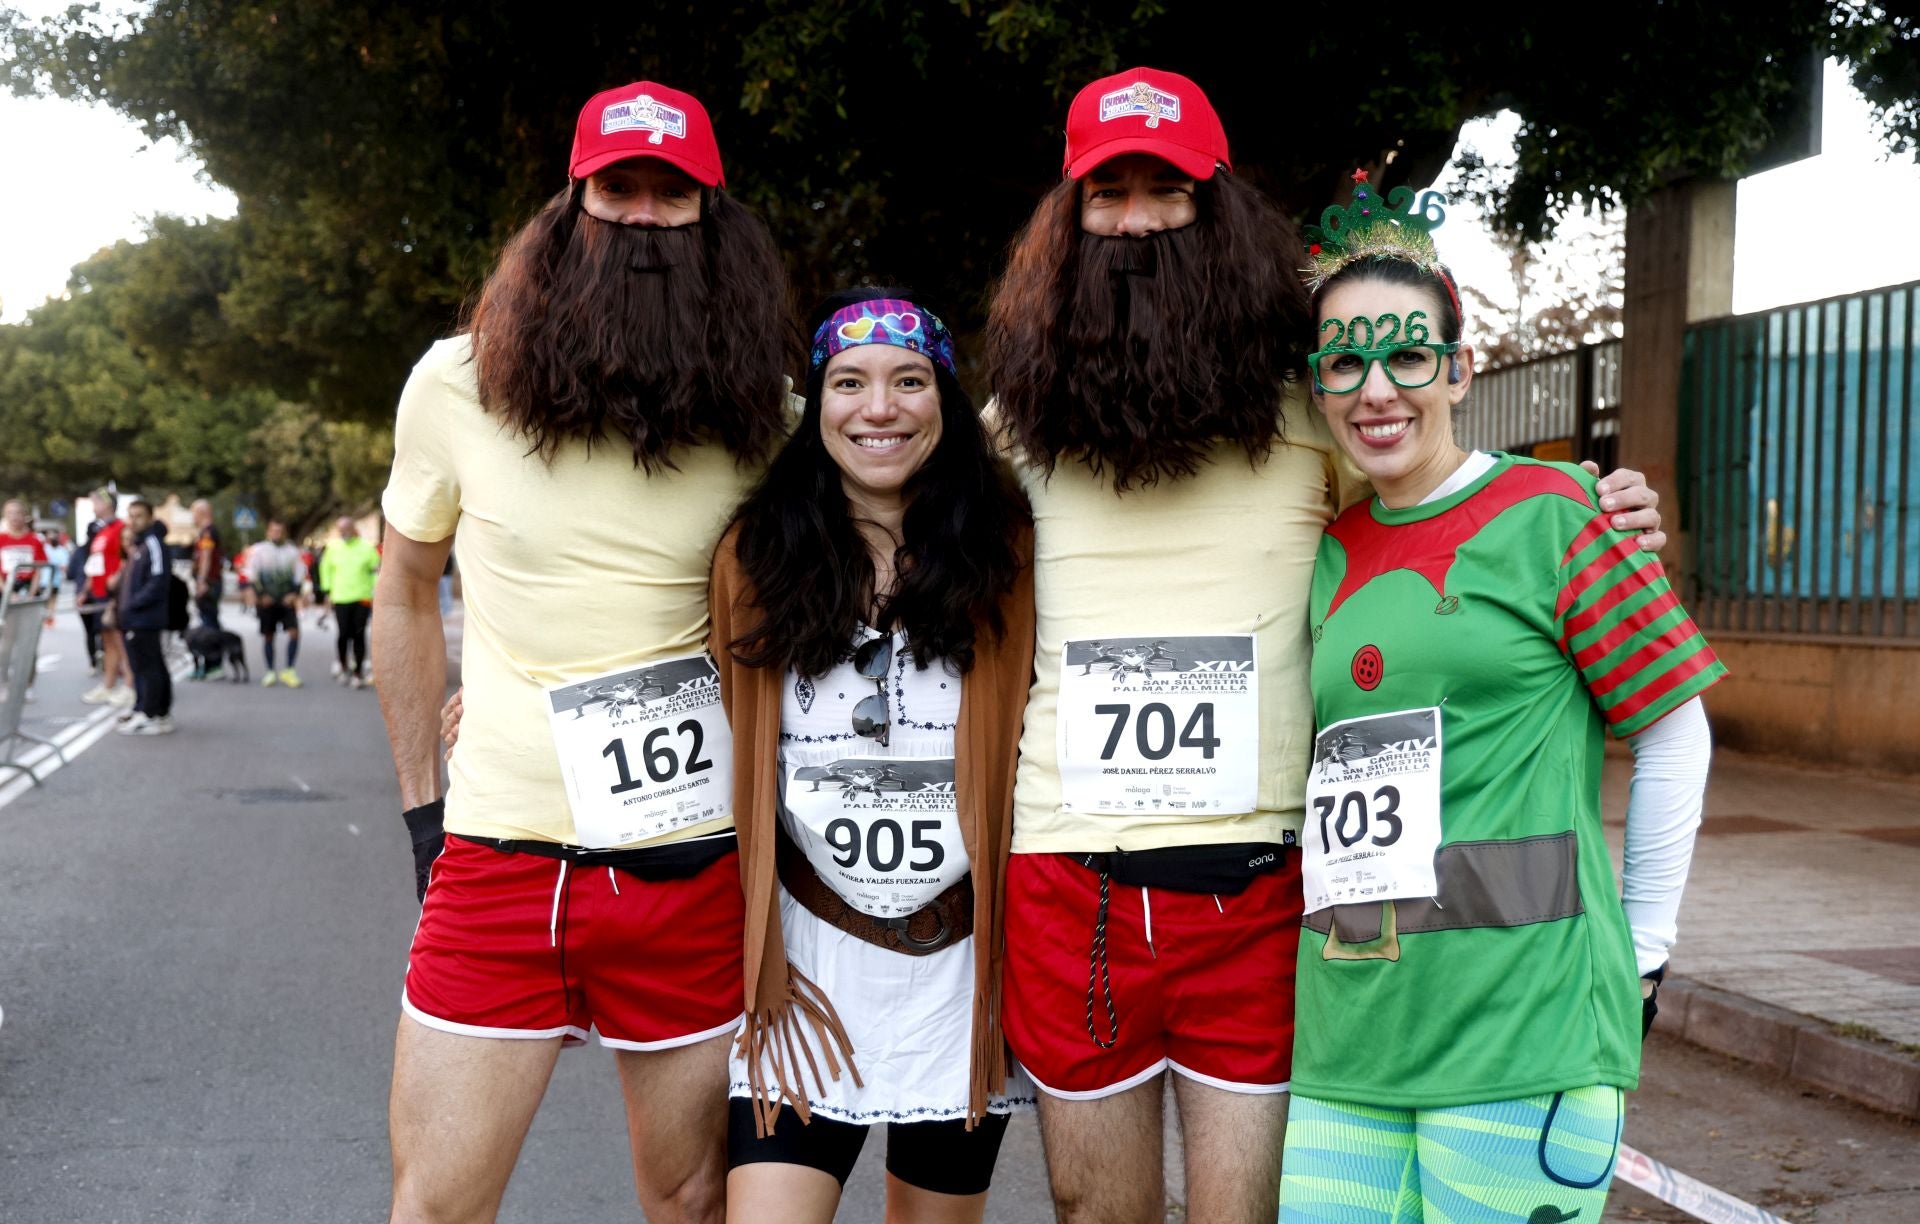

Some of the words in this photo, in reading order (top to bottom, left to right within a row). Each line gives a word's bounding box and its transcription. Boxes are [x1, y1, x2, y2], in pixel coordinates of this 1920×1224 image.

[1320, 311, 1429, 352] 2026
[1190, 660, 1252, 672] XIV
[668, 685, 720, 703] CARRERA
[676, 674, 716, 694] XIV
[611, 713, 659, 728] PALMA
[664, 696, 721, 716] PALMILLA
[640, 705, 662, 716] SAN
[666, 690, 720, 708] SILVESTRE
[1095, 702, 1221, 760] 704
[1377, 736, 1434, 755] XIV
[602, 719, 713, 794] 162
[1367, 757, 1430, 773] SILVESTRE
[1370, 750, 1431, 765] CARRERA
[1102, 766, 1120, 775] JOSÉ
[1120, 767, 1148, 775] DANIEL
[1149, 765, 1174, 775] PÉREZ
[1175, 766, 1217, 775] SERRALVO
[1320, 773, 1361, 785] PALMA
[1366, 763, 1430, 778] PALMILLA
[623, 793, 652, 807] ANTONIO
[653, 784, 687, 799] CORRALES
[687, 777, 710, 790] SANTOS
[917, 781, 956, 792] XI
[1313, 785, 1403, 854] 703
[824, 817, 945, 872] 905
[1248, 852, 1274, 867] eono
[866, 876, 895, 885] VALDÉS
[895, 877, 941, 885] FUENZALIDA
